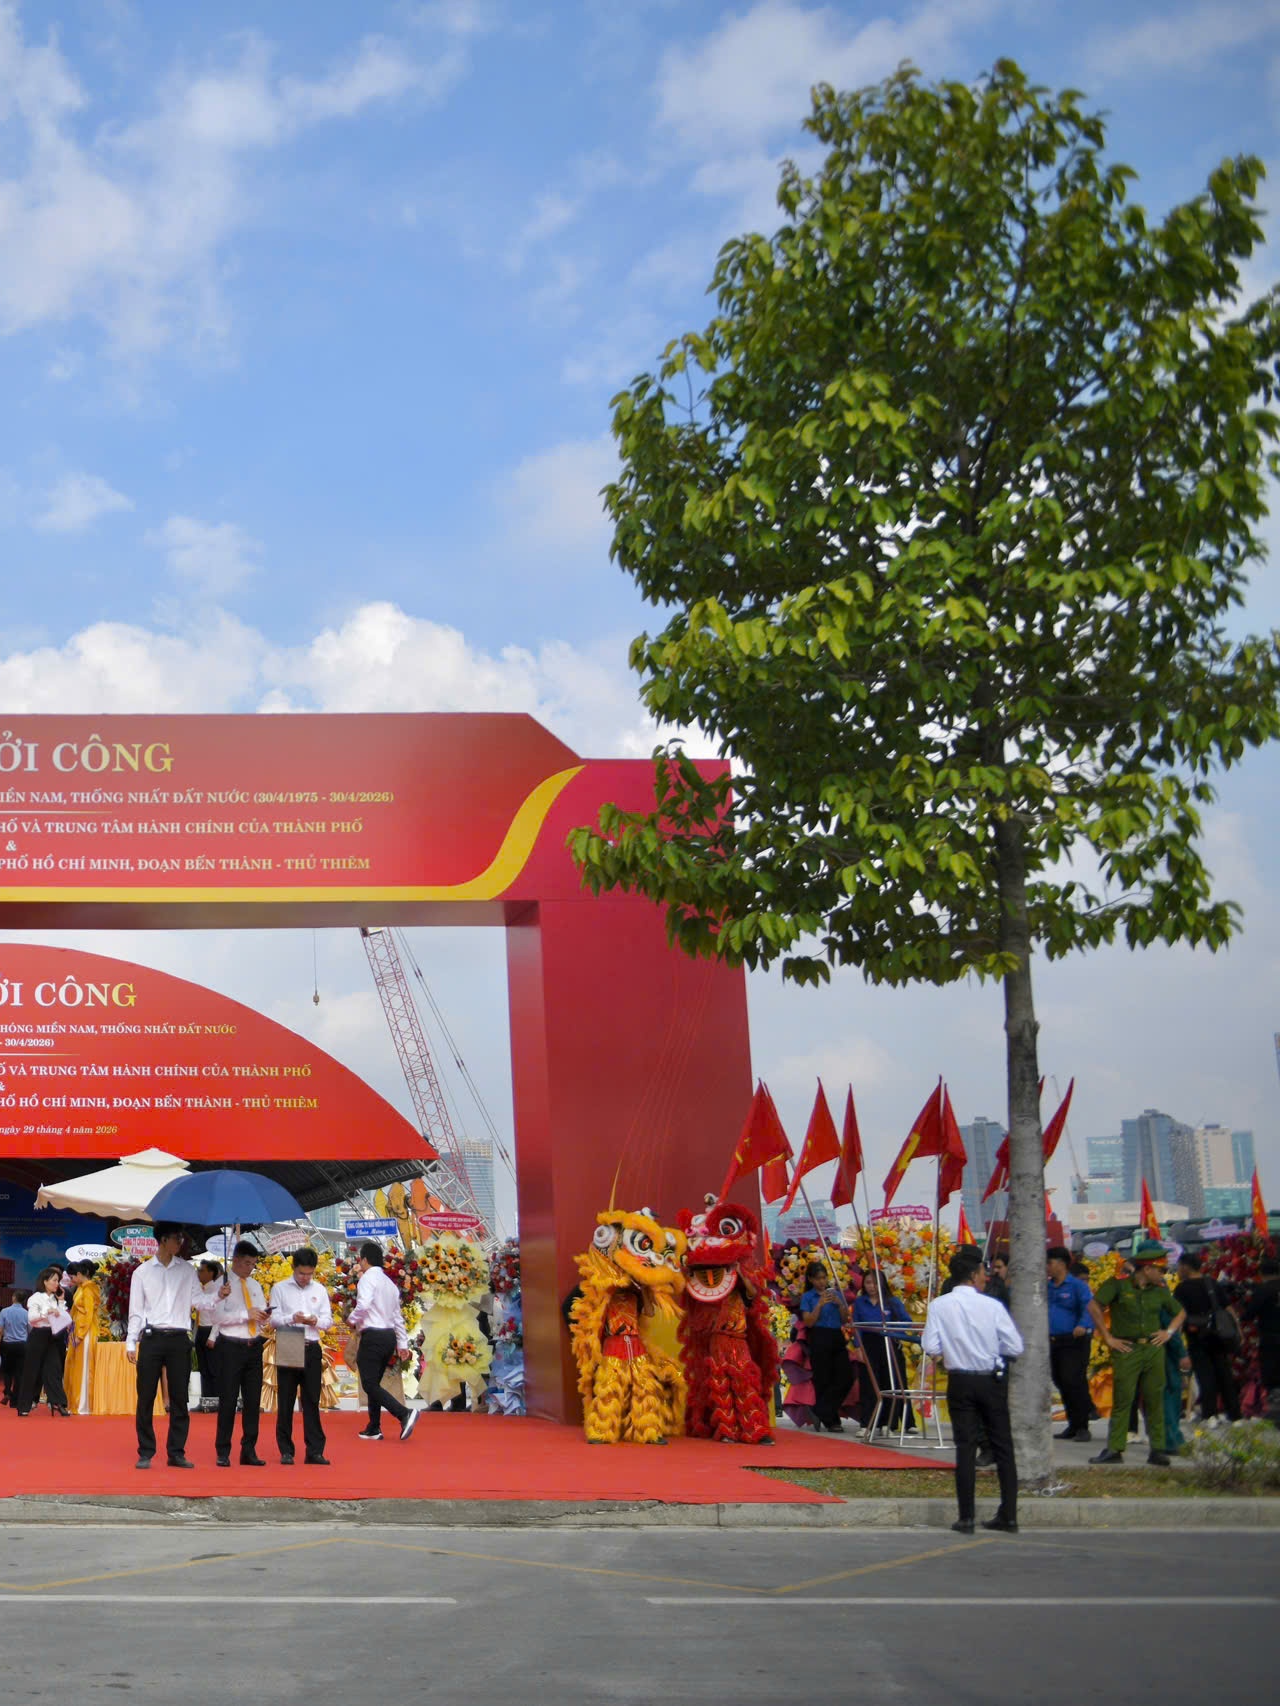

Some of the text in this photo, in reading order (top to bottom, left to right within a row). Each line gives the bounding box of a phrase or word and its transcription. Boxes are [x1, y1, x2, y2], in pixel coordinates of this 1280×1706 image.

[52, 734, 174, 772] CÔNG
[30, 792, 67, 804] NAM,
[70, 788, 123, 803] THỐNG
[128, 788, 169, 803] NHẤT
[173, 788, 203, 803] ĐẤT
[207, 789, 249, 803] NƯỚC
[253, 792, 318, 803] (30/4/1975
[330, 792, 394, 803] 30/4/2026)
[21, 819, 41, 833] VÀ
[44, 822, 97, 833] TRUNG
[101, 819, 133, 834] TÂM
[138, 819, 180, 834] HÀNH
[185, 819, 234, 834] CHÍNH
[239, 818, 269, 833] CỦA
[273, 819, 326, 833] THÀNH
[331, 818, 363, 832] PHỐ
[6, 840, 17, 851] &
[32, 854, 55, 870] HỒ
[58, 856, 85, 870] CHÍ
[89, 859, 134, 871] MINH,
[138, 859, 180, 872] ĐOẠN
[185, 855, 215, 870] BẾN
[219, 856, 272, 870] THÀNH
[284, 855, 316, 870] THỦ
[320, 856, 370, 869] THIÊM
[35, 975, 136, 1007] CÔNG
[36, 1021, 66, 1033] MIỀN
[69, 1025, 98, 1035] NAM,
[100, 1022, 141, 1034] THỐNG
[144, 1022, 176, 1034] NHẤT
[178, 1022, 202, 1034] ĐẤT
[204, 1024, 236, 1034] NƯỚC
[5, 1038, 54, 1047] 30/4/2026)
[9, 1063, 27, 1076] VÀ
[30, 1066, 77, 1076] TRUNG
[80, 1063, 109, 1076] TÂM
[113, 1064, 151, 1076] HÀNH
[155, 1064, 198, 1076] CHÍNH
[202, 1063, 229, 1076] CỦA
[232, 1064, 279, 1076] THÀNH
[283, 1064, 311, 1076] PHỐ
[19, 1093, 39, 1107] HỒ
[42, 1095, 66, 1107] CHÍ
[70, 1097, 110, 1109] MINH,
[113, 1098, 151, 1110] ĐOẠN
[154, 1094, 182, 1108] BẾN
[185, 1096, 232, 1108] THÀNH
[242, 1095, 270, 1108] THỦ
[274, 1096, 317, 1108] THIÊM
[23, 1125, 35, 1135] 29
[36, 1125, 63, 1135] tháng
[65, 1126, 71, 1134] 4
[73, 1126, 93, 1134] năm
[95, 1126, 117, 1135] 2026
